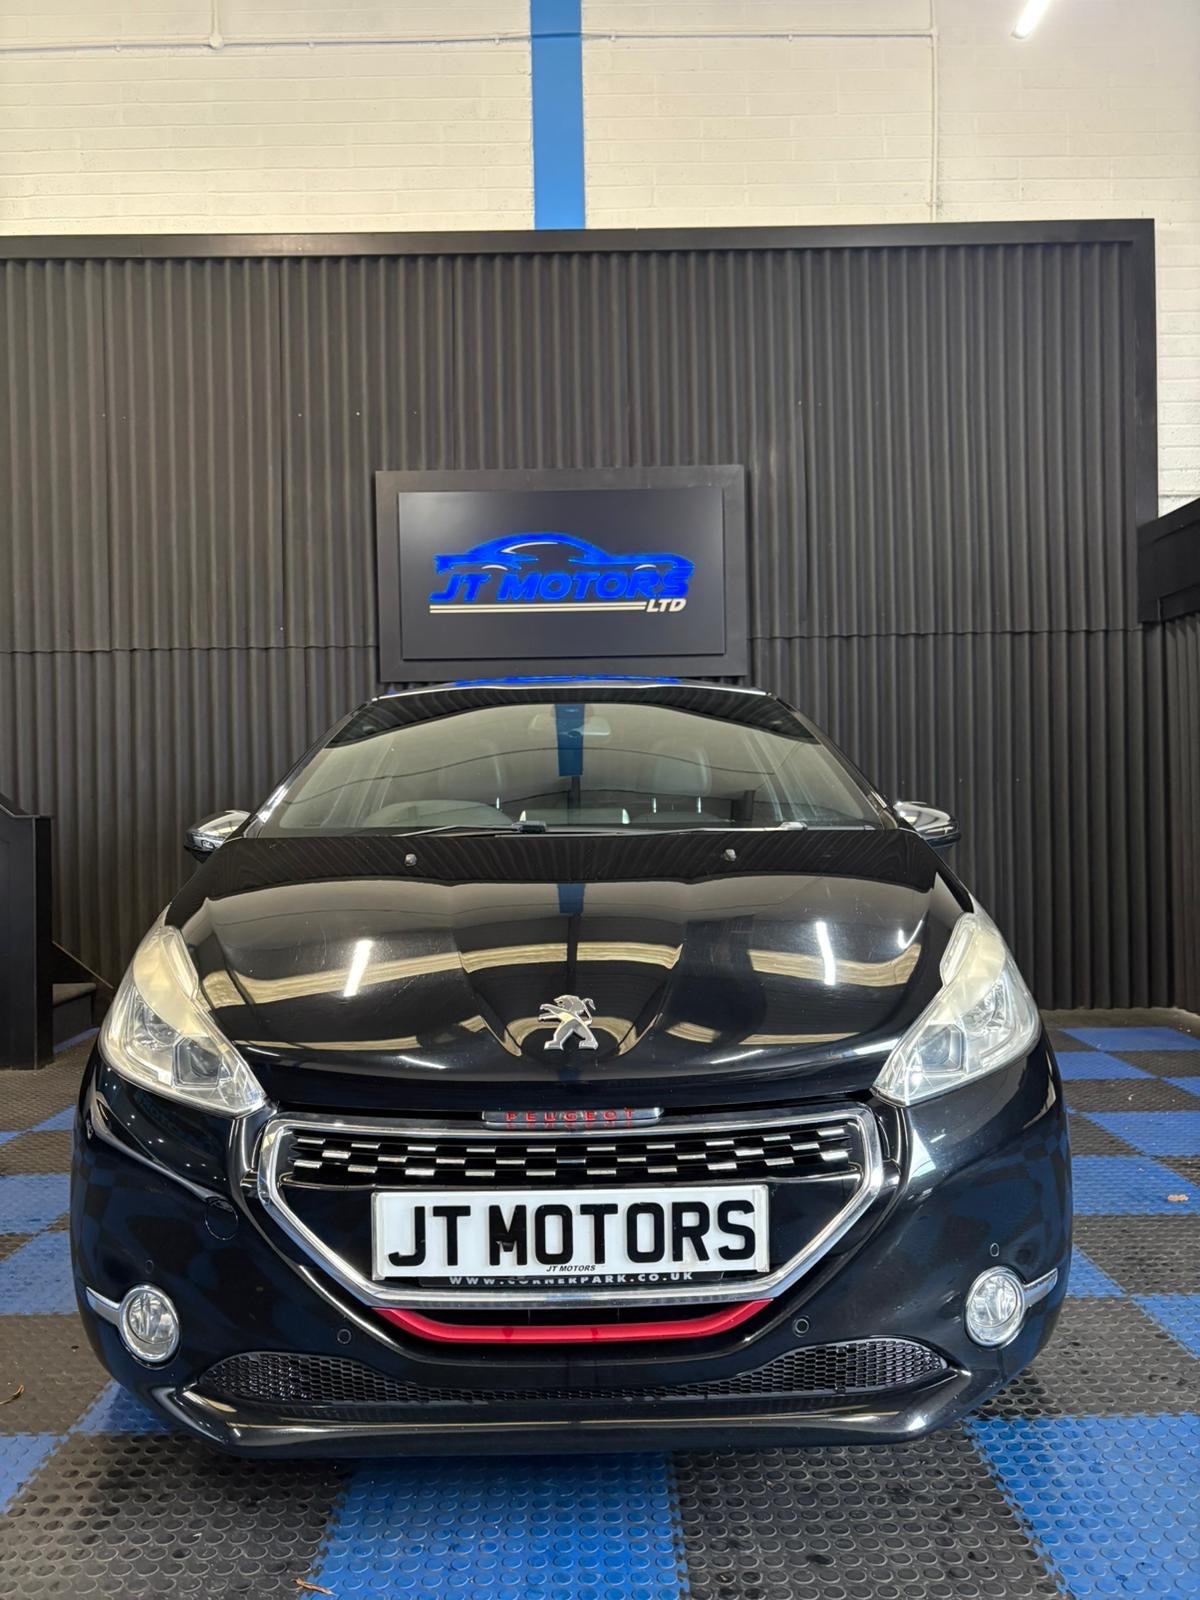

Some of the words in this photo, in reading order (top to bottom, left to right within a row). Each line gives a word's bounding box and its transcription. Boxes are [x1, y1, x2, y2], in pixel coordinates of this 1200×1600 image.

[429, 573, 491, 602] JT
[497, 571, 689, 601] MOTORS
[646, 598, 687, 612] LTD
[505, 1109, 635, 1122] PEUGEOT
[388, 1206, 471, 1267] JT
[488, 1200, 756, 1266] MOTORS
